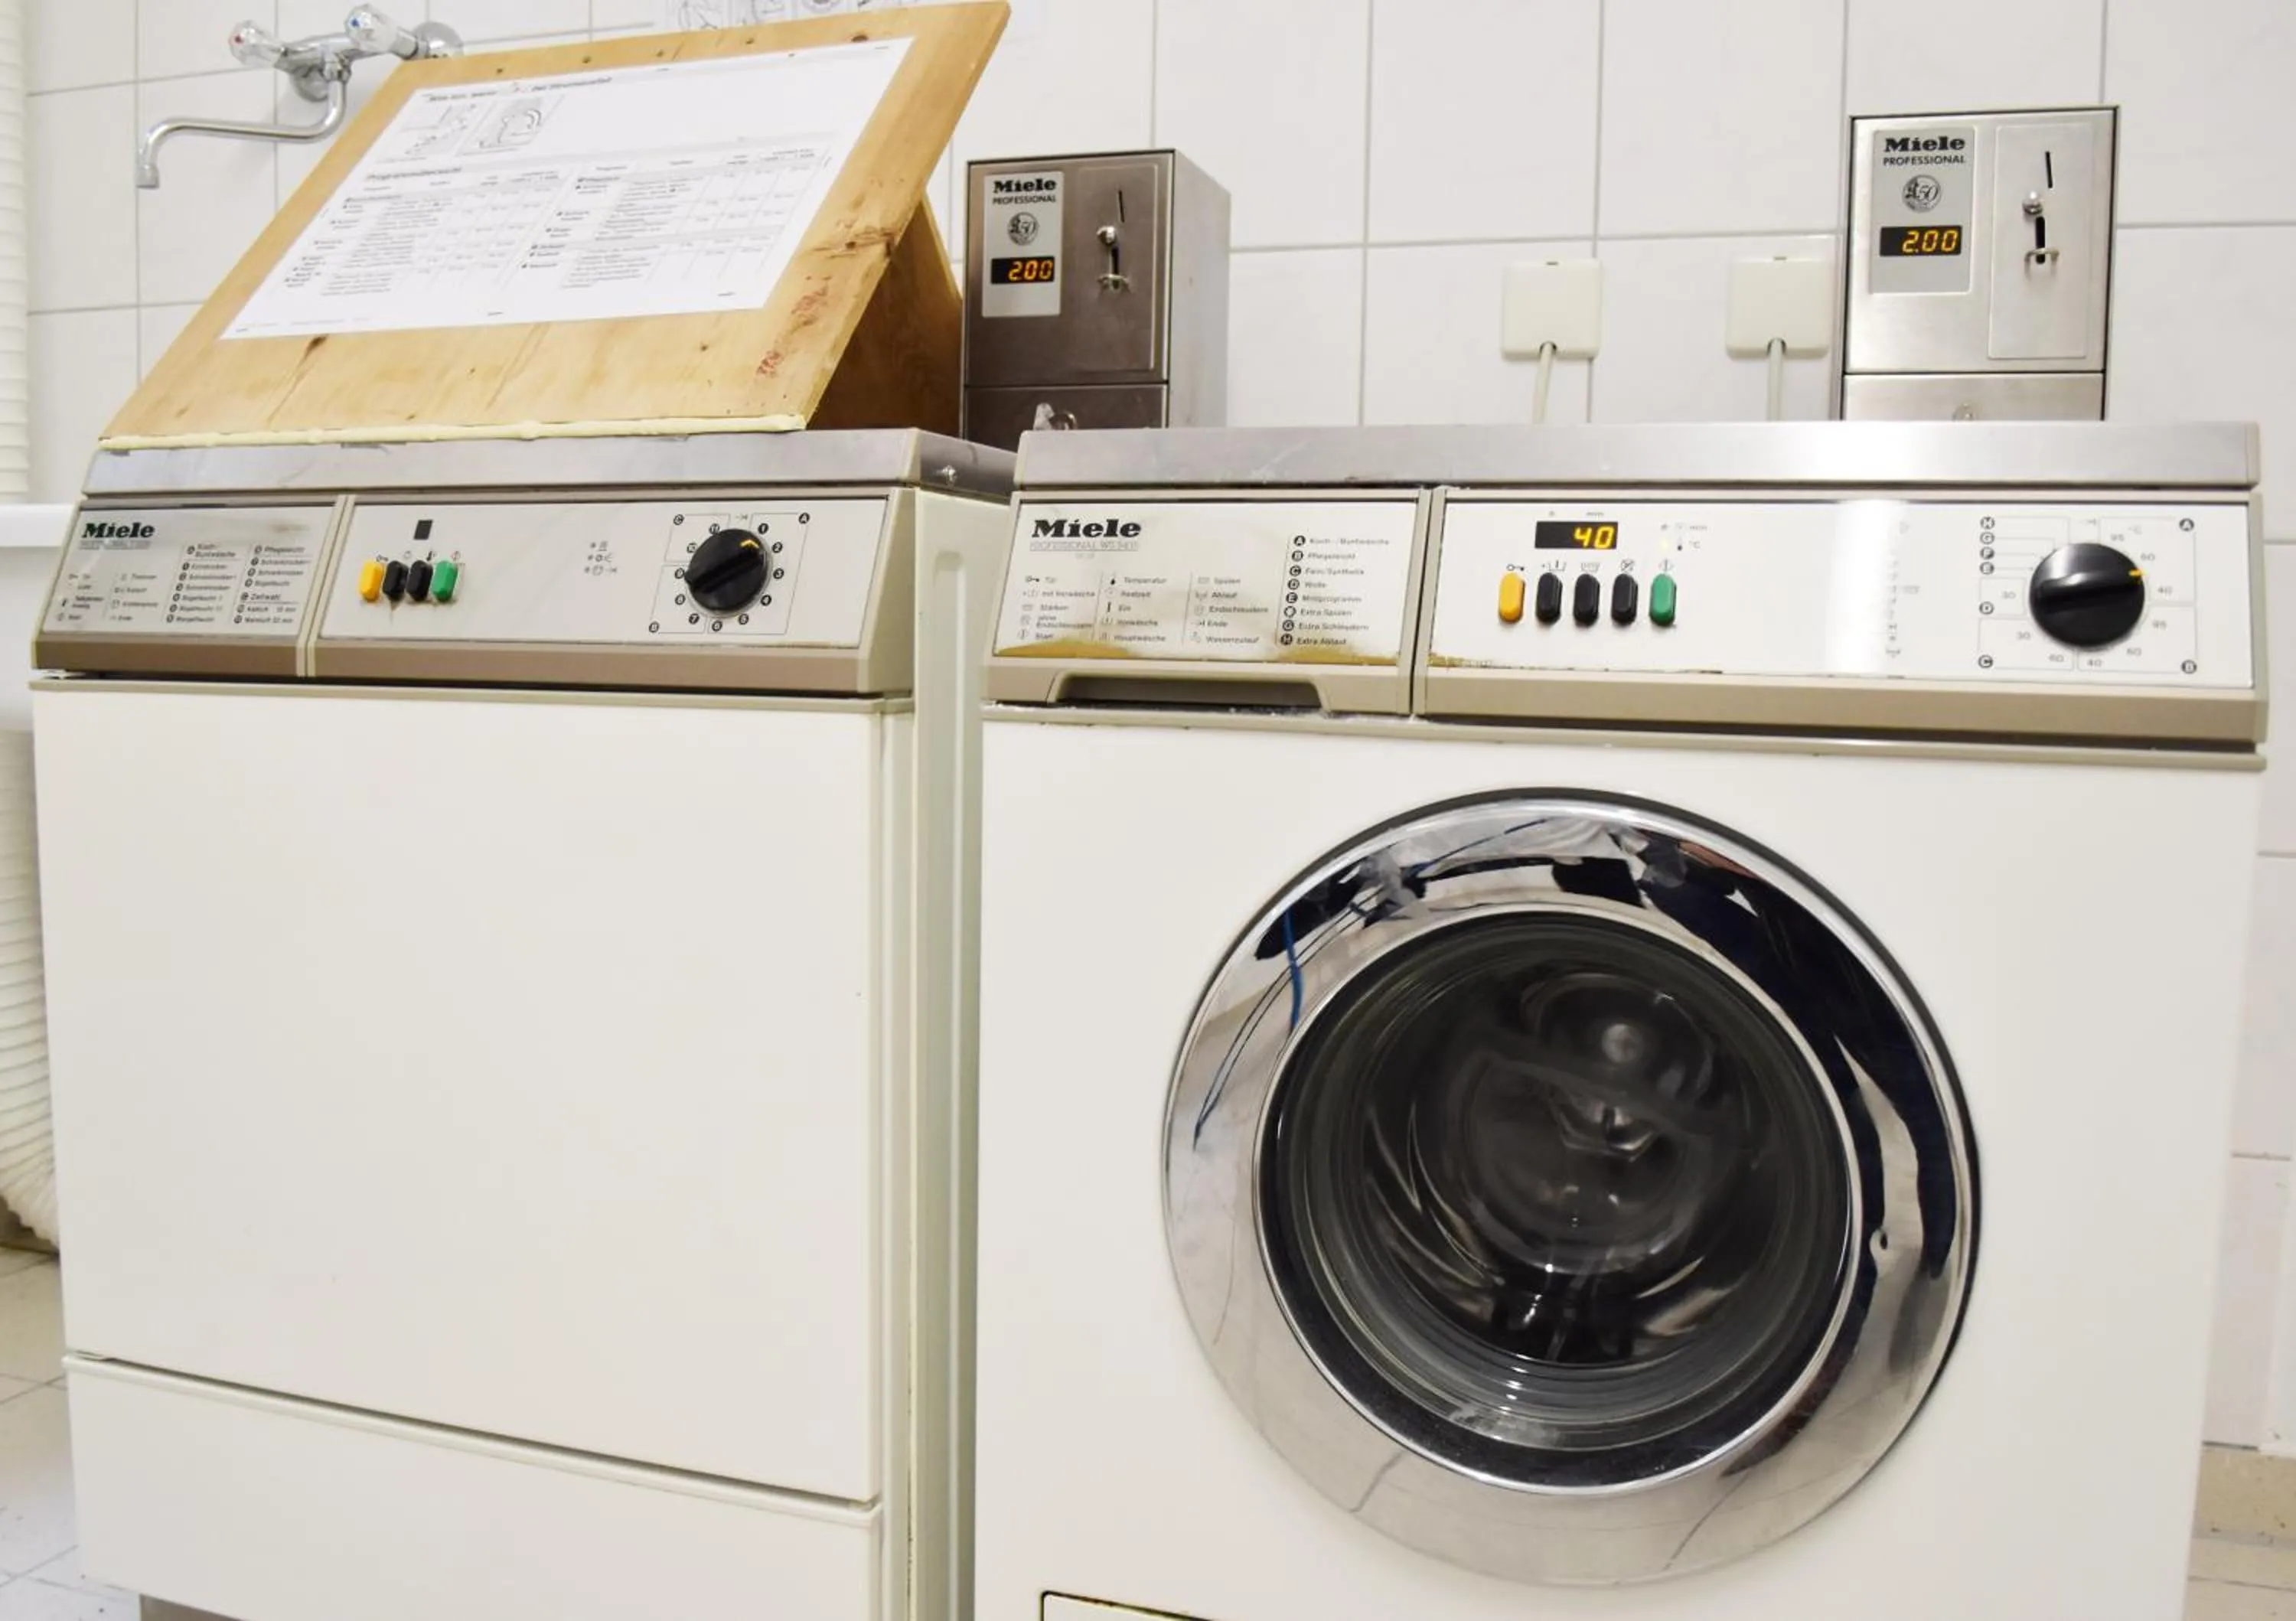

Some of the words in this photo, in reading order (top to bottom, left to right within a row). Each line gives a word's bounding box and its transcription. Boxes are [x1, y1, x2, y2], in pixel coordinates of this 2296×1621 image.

[1884, 135, 1965, 152] Miele
[1883, 155, 1966, 166] PROFESSIONAL
[993, 178, 1056, 193] Miele
[993, 194, 1056, 204] PROFESSIONAL
[1901, 230, 1959, 253] 2.00
[82, 523, 155, 538] Miele
[1032, 519, 1141, 537] Miele
[1574, 526, 1615, 549] 40
